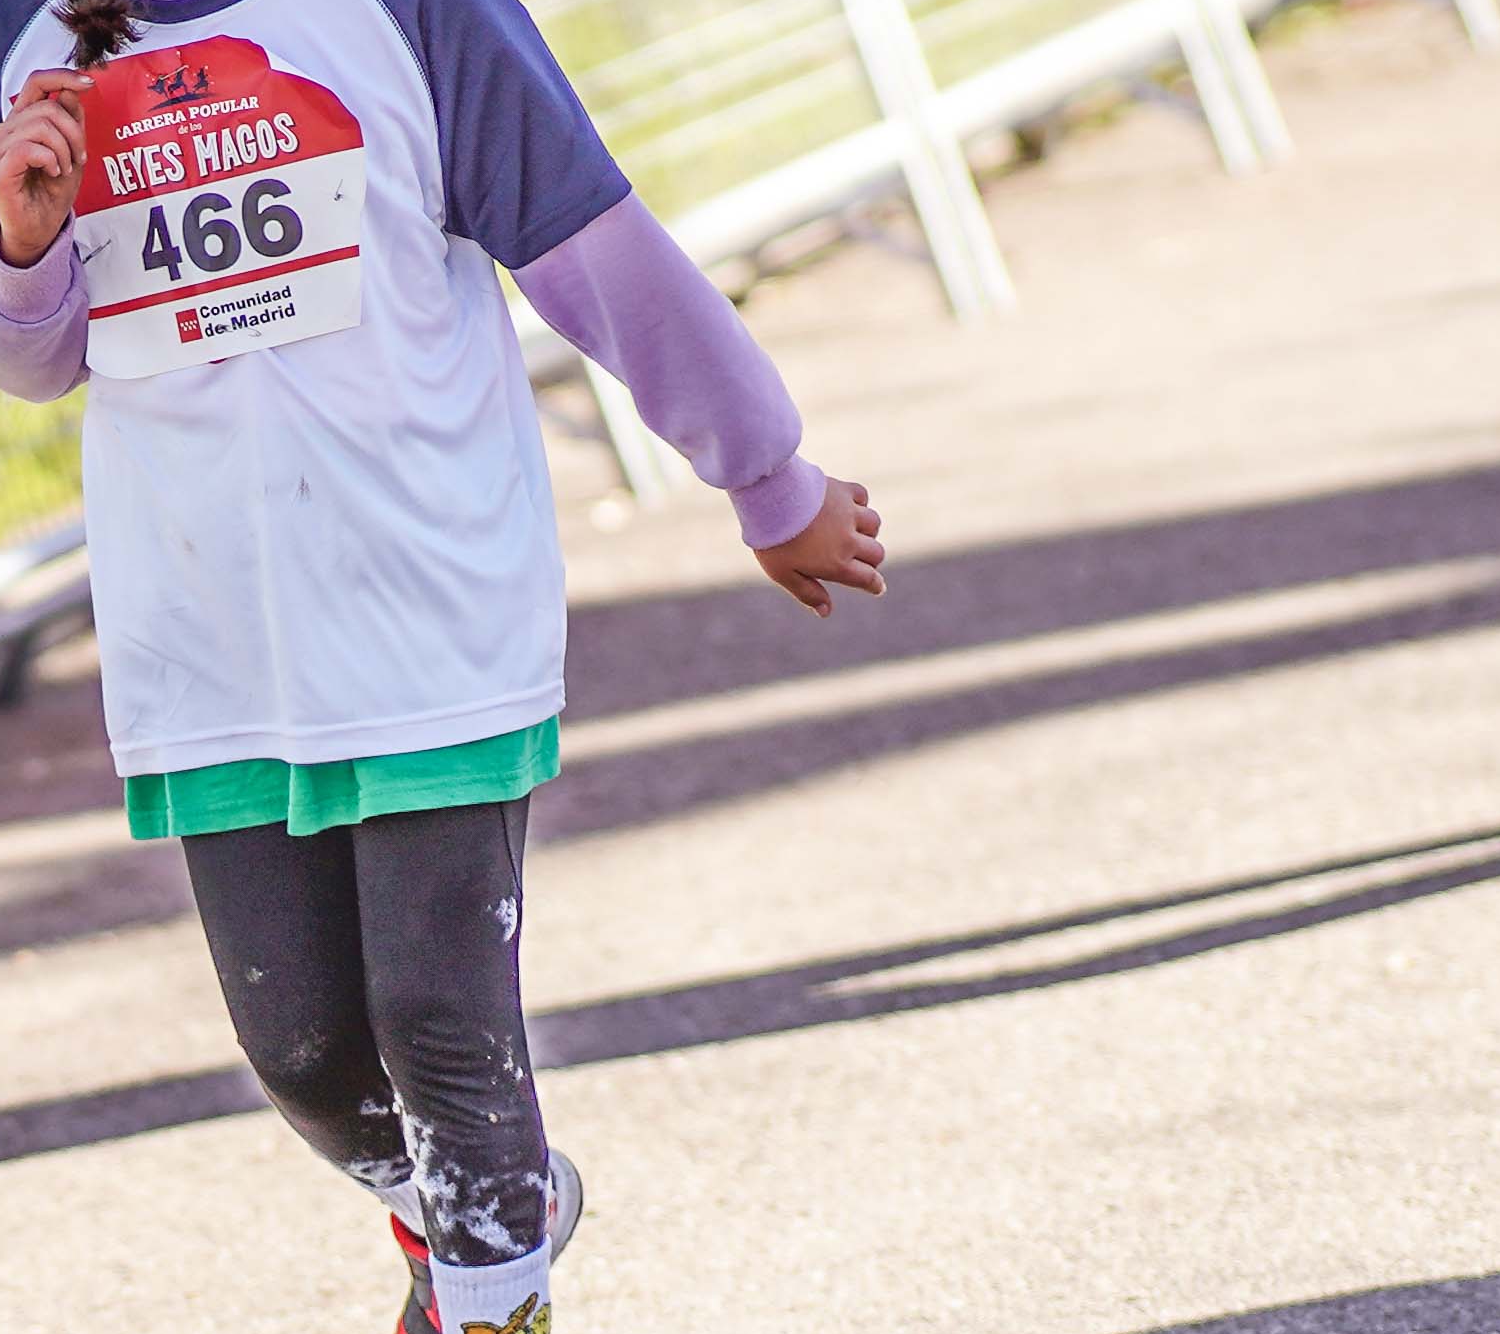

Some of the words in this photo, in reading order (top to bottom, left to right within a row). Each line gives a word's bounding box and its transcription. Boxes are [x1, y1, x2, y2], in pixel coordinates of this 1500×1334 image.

[115, 110, 186, 141] CARRERA
[188, 96, 260, 120] POPULAR
[177, 124, 188, 136] de
[189, 122, 203, 133] los
[102, 141, 186, 197] REYES
[192, 112, 300, 178] MAGOS
[142, 178, 304, 282] 466
[199, 285, 292, 319] Comunidad
[204, 323, 229, 338] de
[230, 302, 297, 331] Madrid
